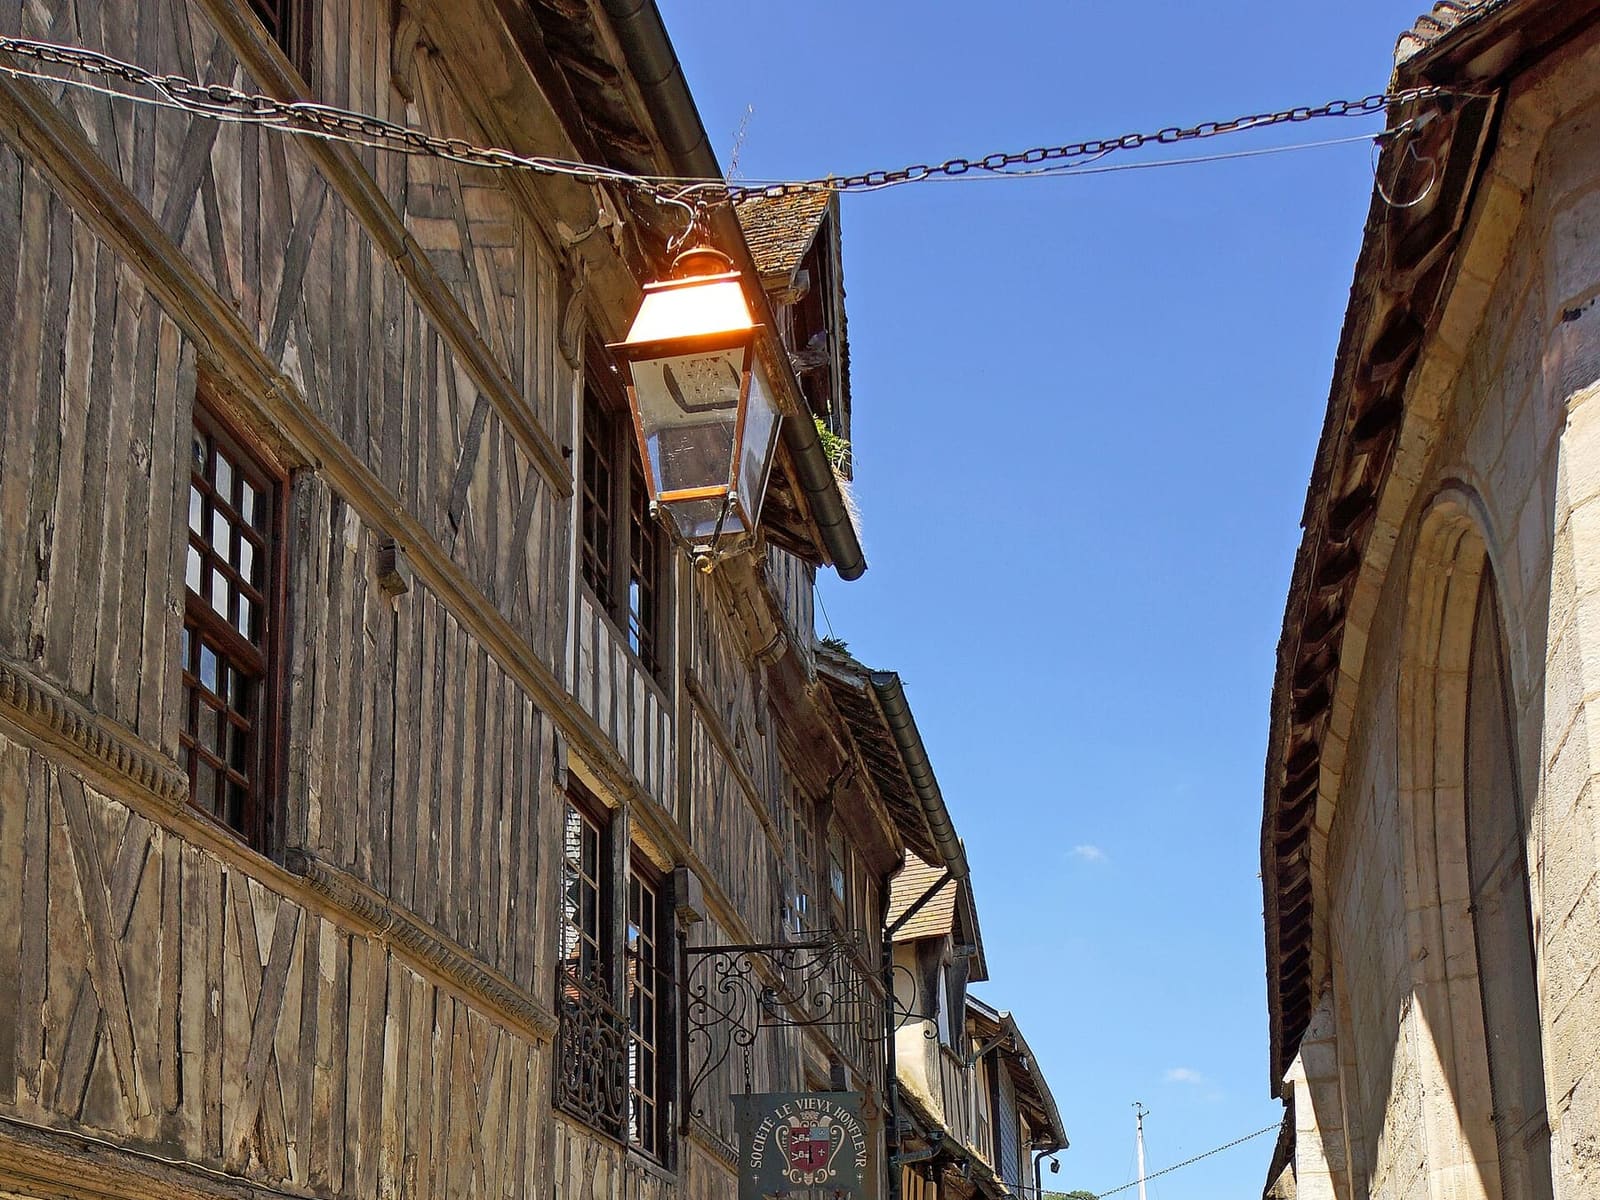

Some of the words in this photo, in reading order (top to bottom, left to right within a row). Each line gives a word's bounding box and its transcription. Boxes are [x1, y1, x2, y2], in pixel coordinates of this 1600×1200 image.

[775, 1103, 792, 1119] LE
[795, 1098, 833, 1113] VIEVX
[833, 1107, 867, 1168] HONFLEVR
